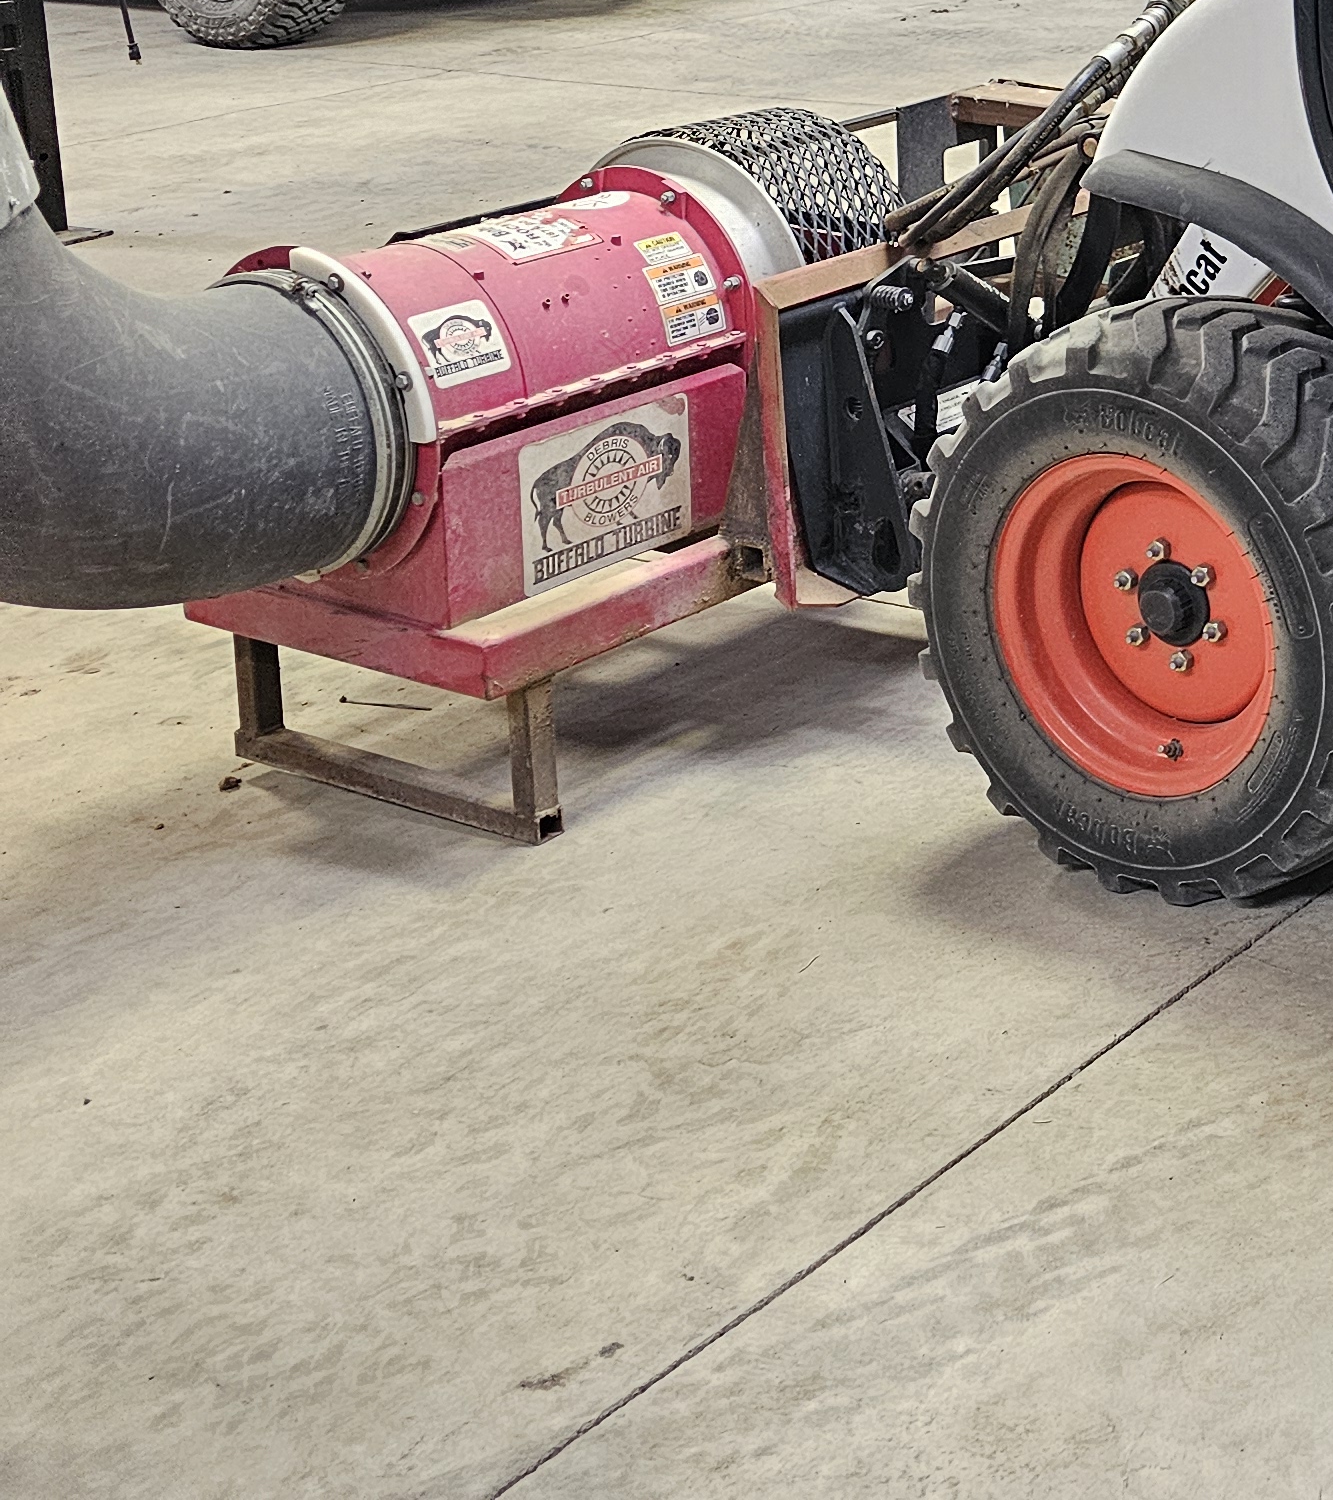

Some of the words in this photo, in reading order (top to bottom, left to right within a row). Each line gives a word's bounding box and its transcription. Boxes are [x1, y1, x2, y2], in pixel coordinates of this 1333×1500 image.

[668, 261, 692, 272] WARNING
[683, 298, 706, 310] WARNING
[586, 438, 630, 462] DEBRIS
[560, 467, 636, 503] TURBULENT
[637, 459, 659, 477] AIR
[583, 495, 639, 525] BLOWERS
[532, 533, 606, 585] BUFFALO
[612, 505, 682, 552] TURBINE
